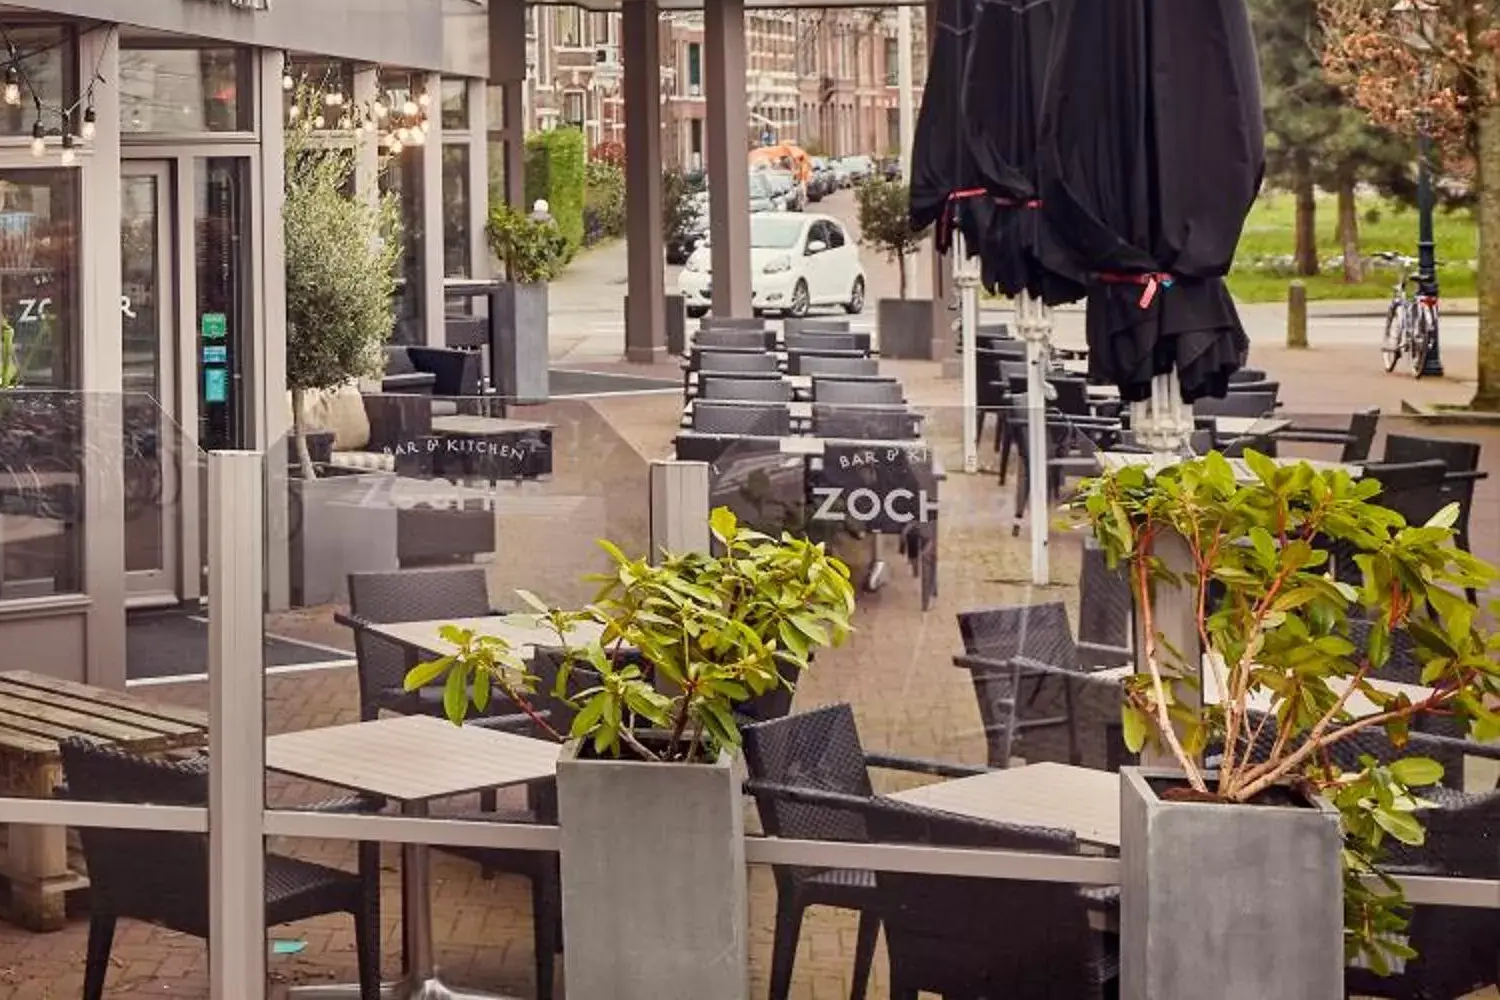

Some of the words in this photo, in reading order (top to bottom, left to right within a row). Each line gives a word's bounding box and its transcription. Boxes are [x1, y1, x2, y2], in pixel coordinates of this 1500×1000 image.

[383, 440, 420, 457] BAR
[446, 438, 526, 462] KITCHEN
[839, 451, 879, 468] BAR
